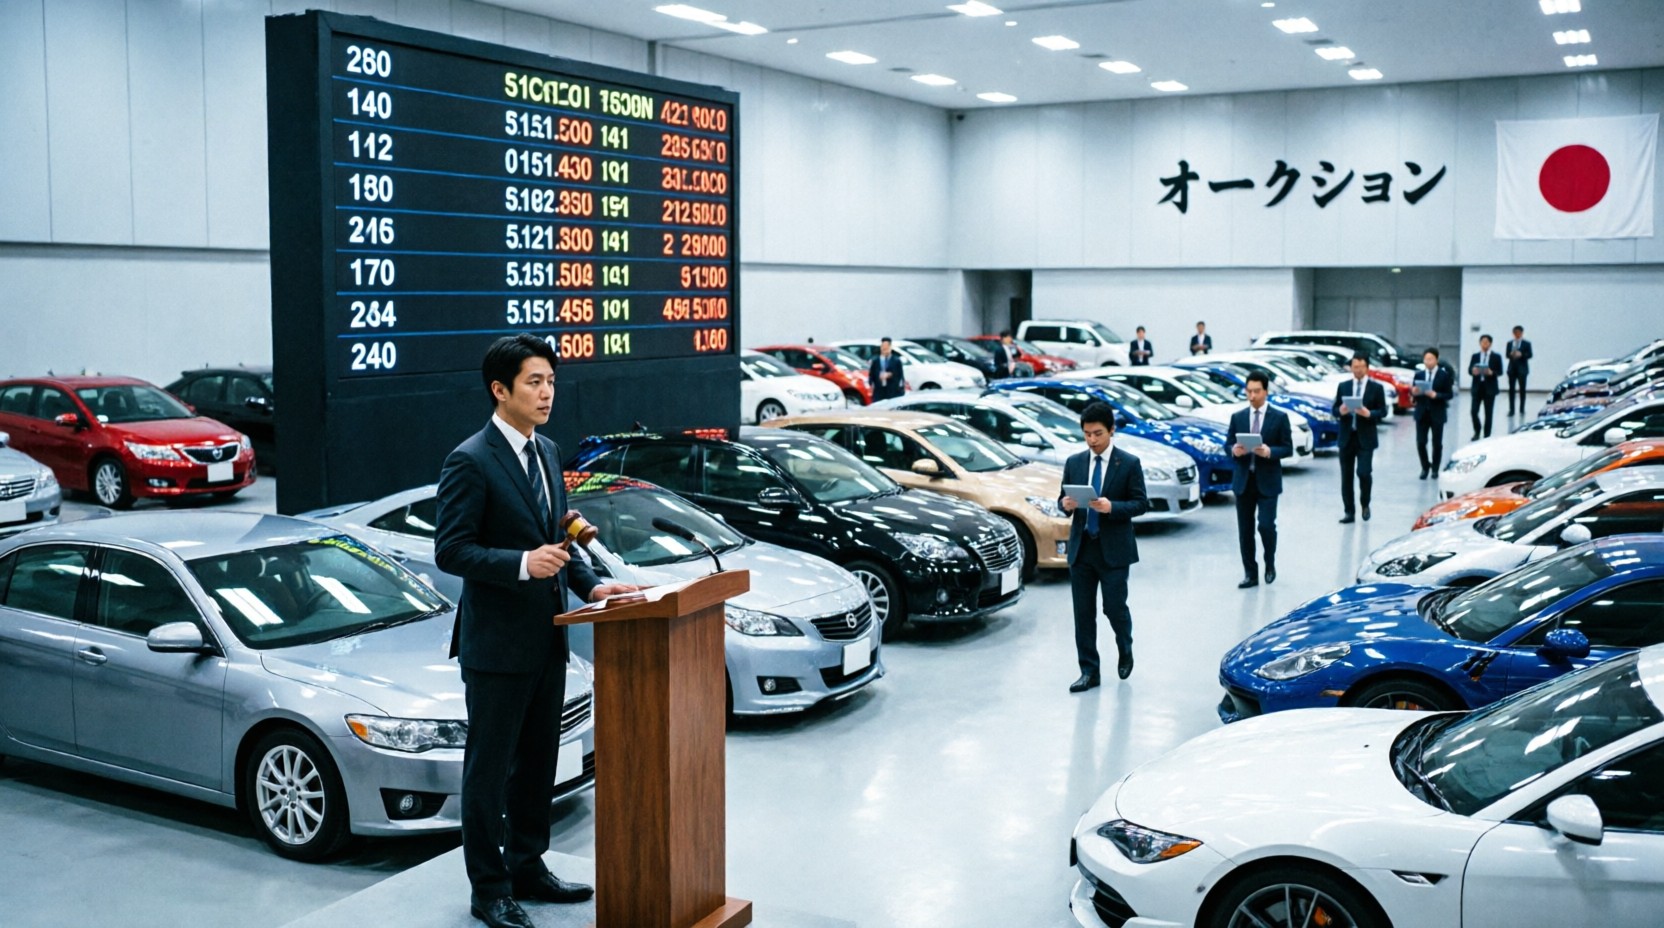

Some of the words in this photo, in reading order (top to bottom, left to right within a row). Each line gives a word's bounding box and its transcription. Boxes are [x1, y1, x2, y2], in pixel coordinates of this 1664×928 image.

[348, 88, 391, 119] 140
[601, 125, 628, 149] 141
[349, 131, 392, 161] 112
[1157, 160, 1447, 214] オークション
[349, 216, 394, 244] 216
[351, 259, 394, 286] 170
[352, 342, 396, 370] 240
